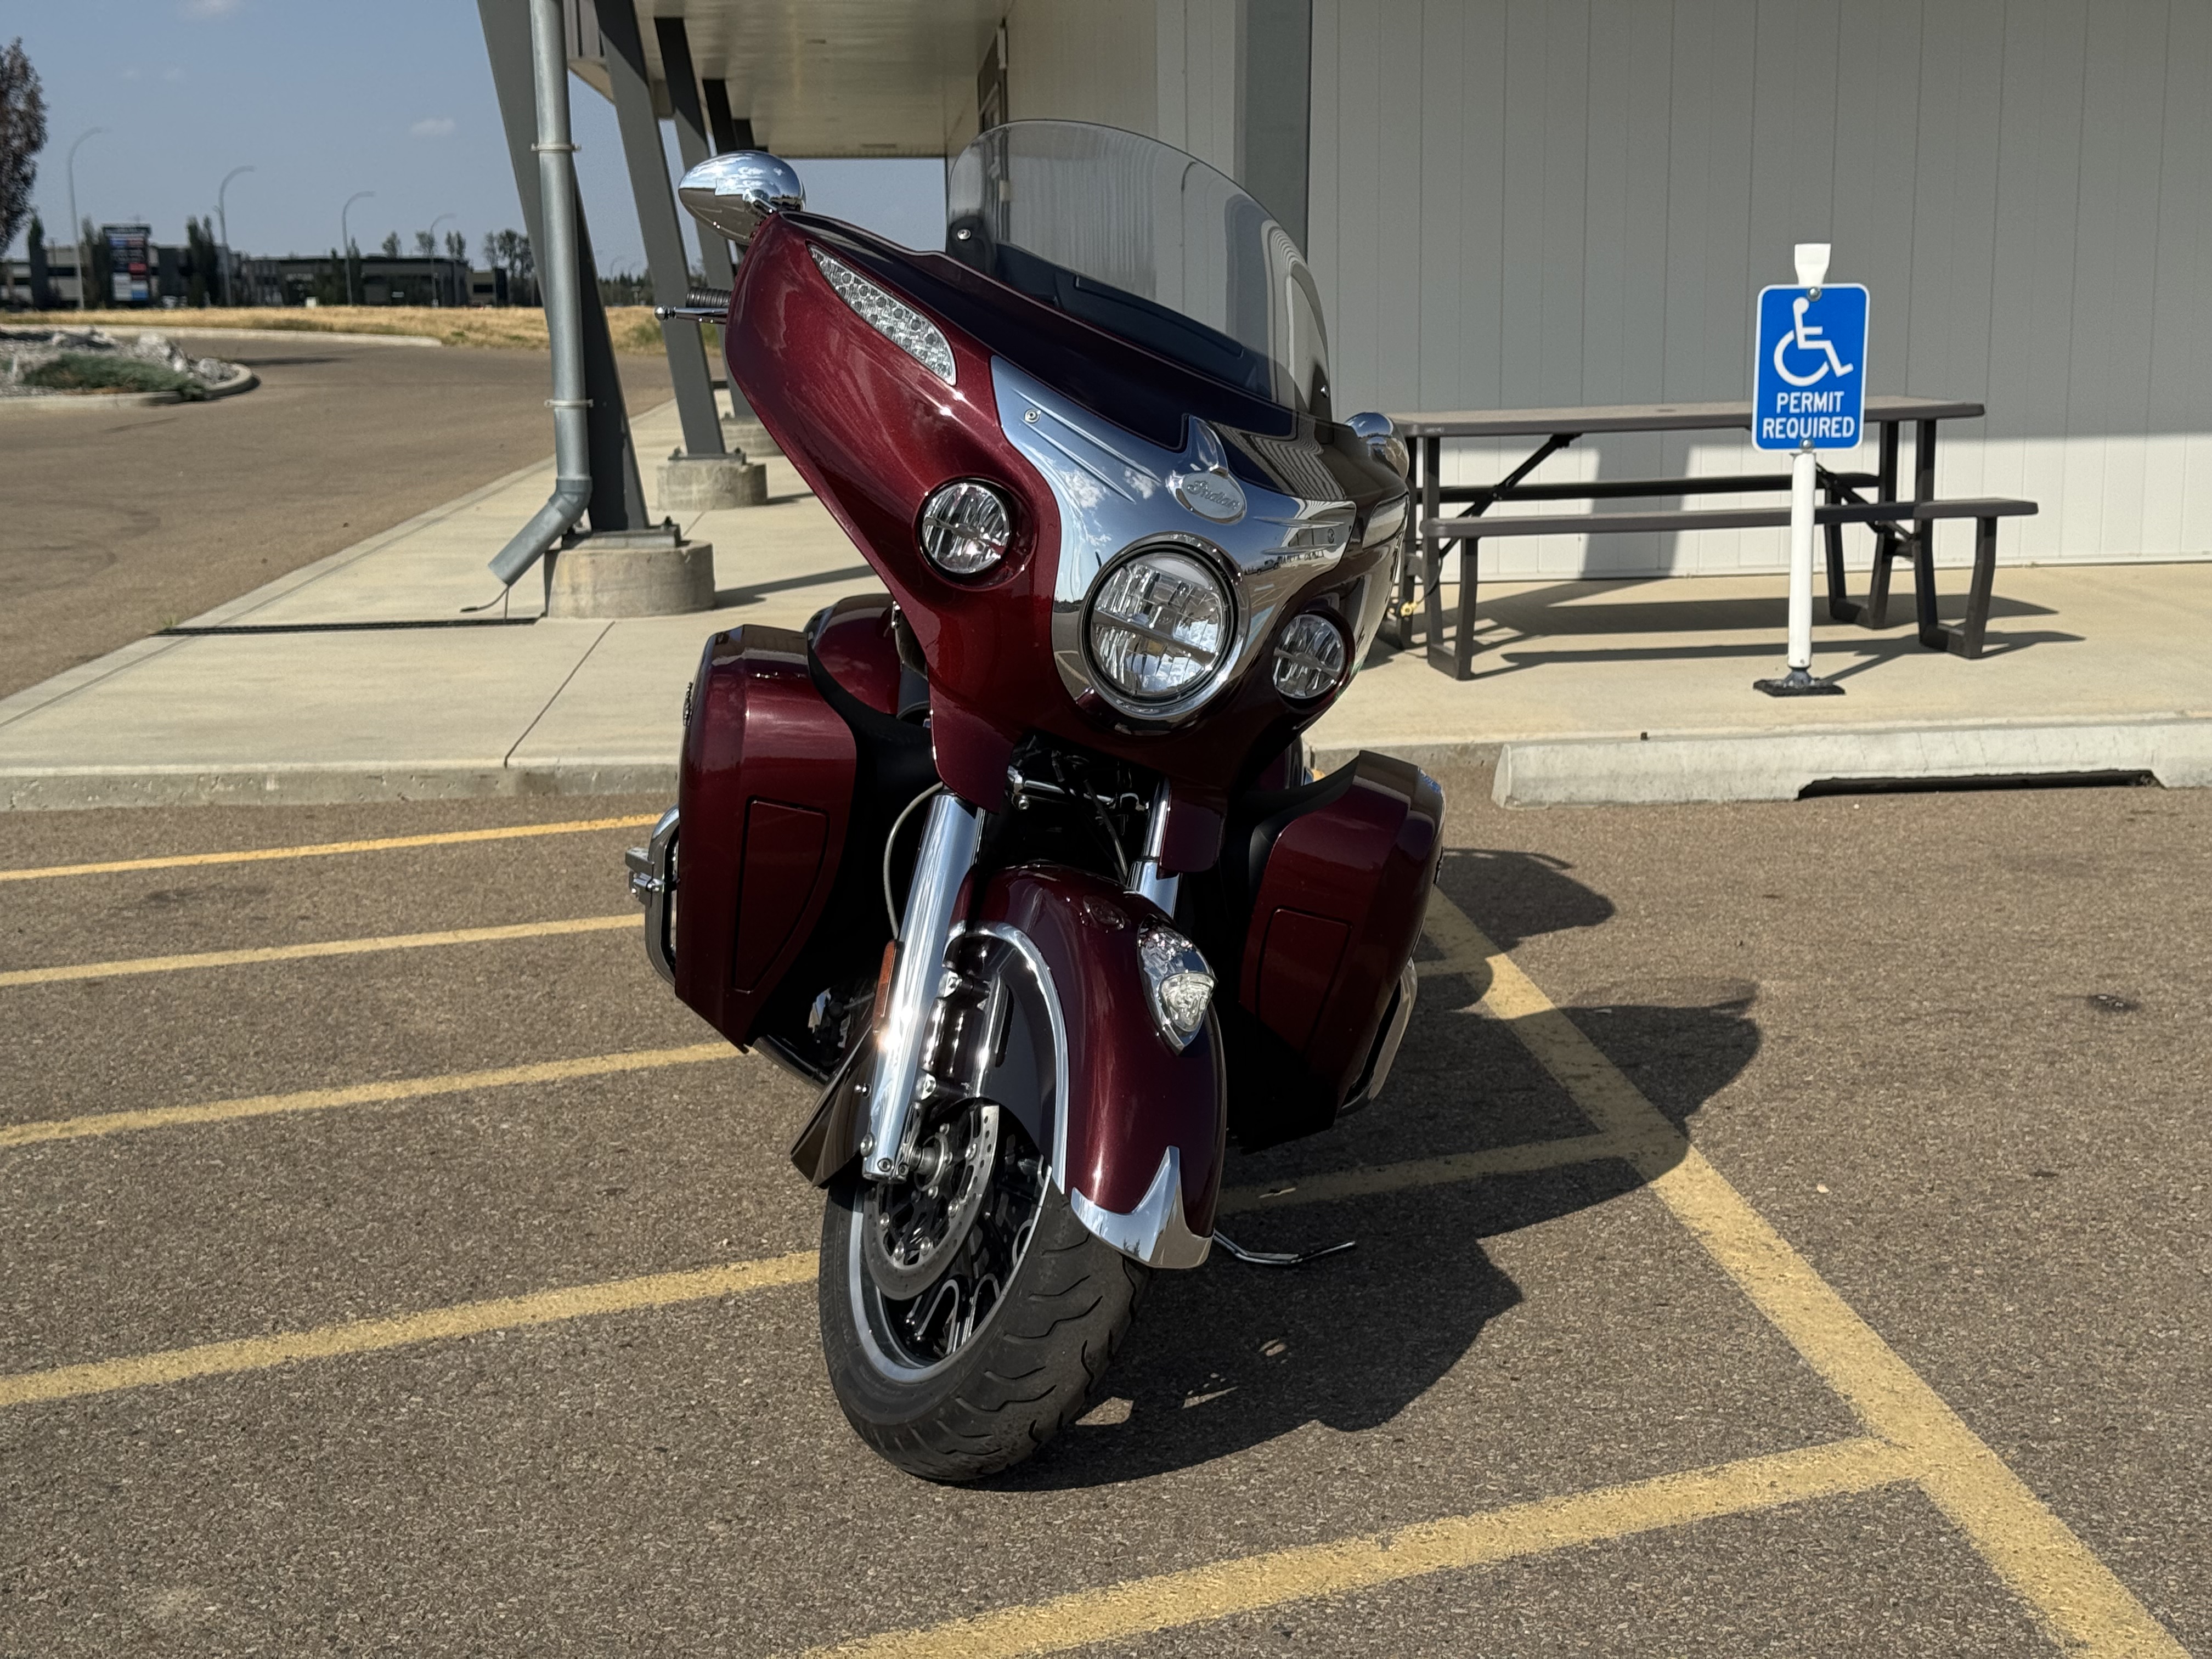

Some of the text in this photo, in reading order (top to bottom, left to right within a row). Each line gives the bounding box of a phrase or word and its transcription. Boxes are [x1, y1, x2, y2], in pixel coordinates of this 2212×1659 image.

[1776, 391, 1845, 414] PERMIT
[1762, 416, 1855, 439] REQUIRED
[1186, 480, 1242, 509] Indian
